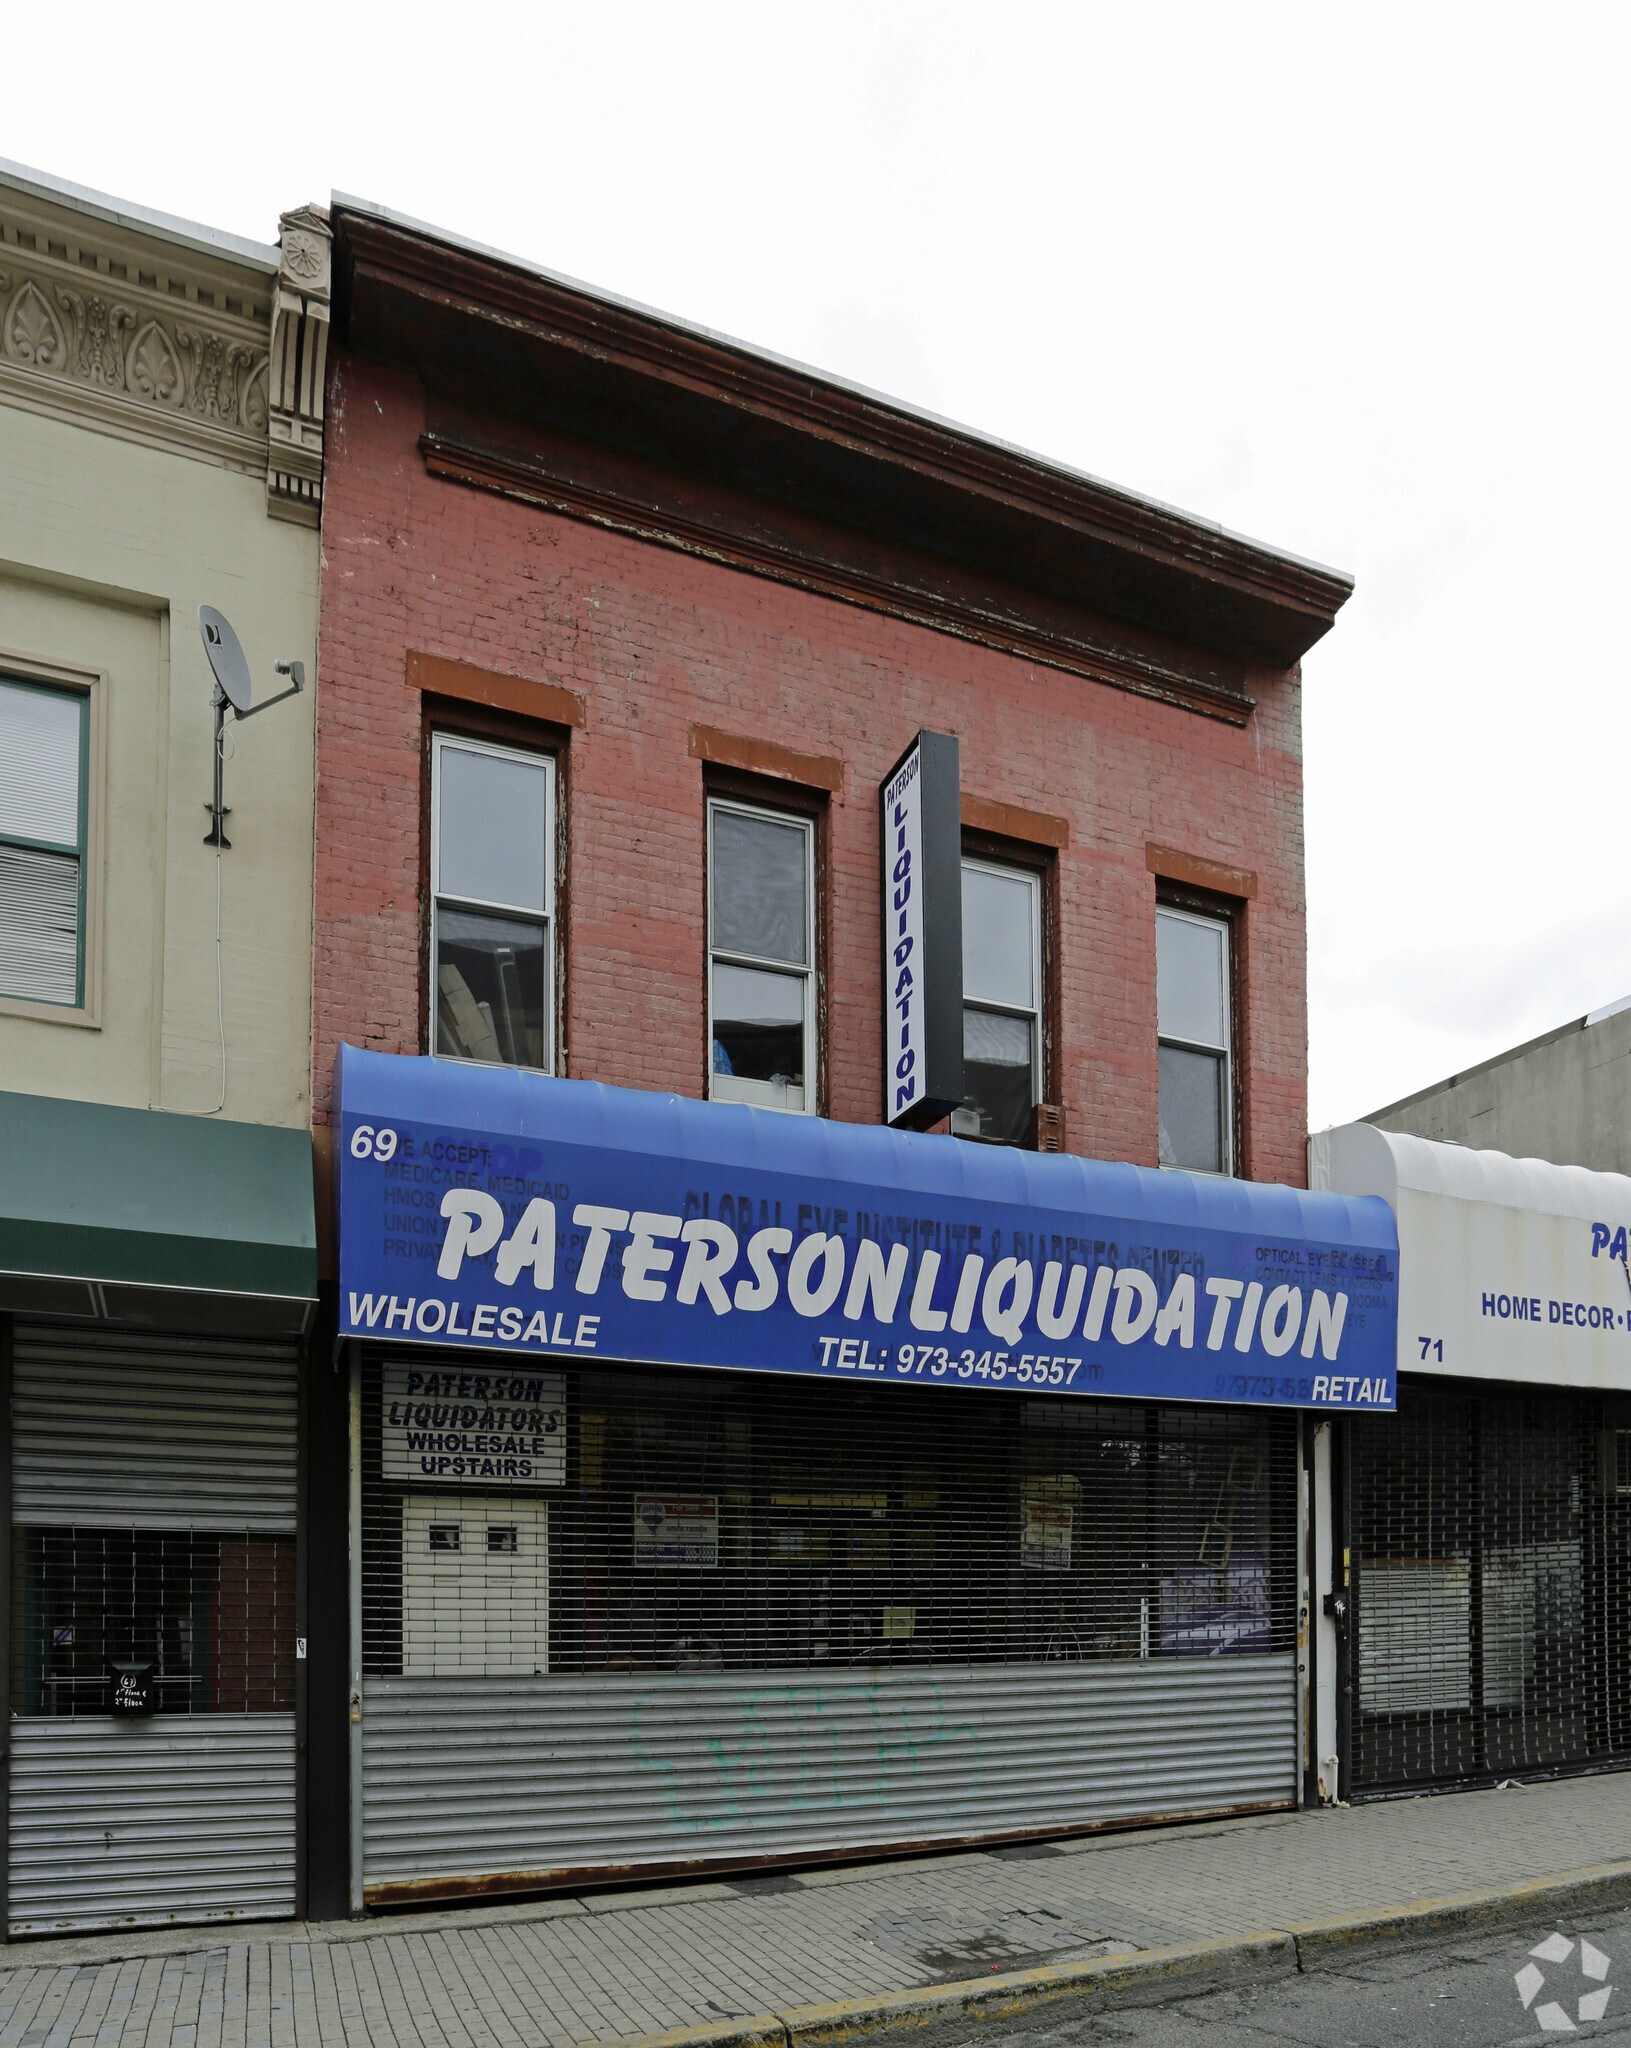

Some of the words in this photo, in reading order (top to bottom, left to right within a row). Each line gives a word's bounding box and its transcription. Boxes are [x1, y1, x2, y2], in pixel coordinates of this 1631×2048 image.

[887, 752, 919, 811] PATERSON
[893, 802, 916, 1112] LIQUIDATION
[351, 1125, 398, 1162] 69
[487, 1176, 570, 1201] MEDICAID
[384, 1213, 437, 1234] UNION
[1592, 1222, 1631, 1261] PA
[349, 1291, 601, 1349] WHOLESALE
[1482, 1293, 1542, 1322] HOME
[818, 1336, 887, 1372] TEL:
[896, 1344, 1083, 1386] 973-345-5557
[1418, 1336, 1443, 1362] 71
[407, 1372, 544, 1402] PATERSON
[1311, 1375, 1393, 1404] RETAIL
[389, 1401, 560, 1434] LIQUIDATORS
[407, 1432, 545, 1455] WHOLESALE
[421, 1456, 532, 1477] UPSTAIRS
[123, 1677, 135, 1687] 67
